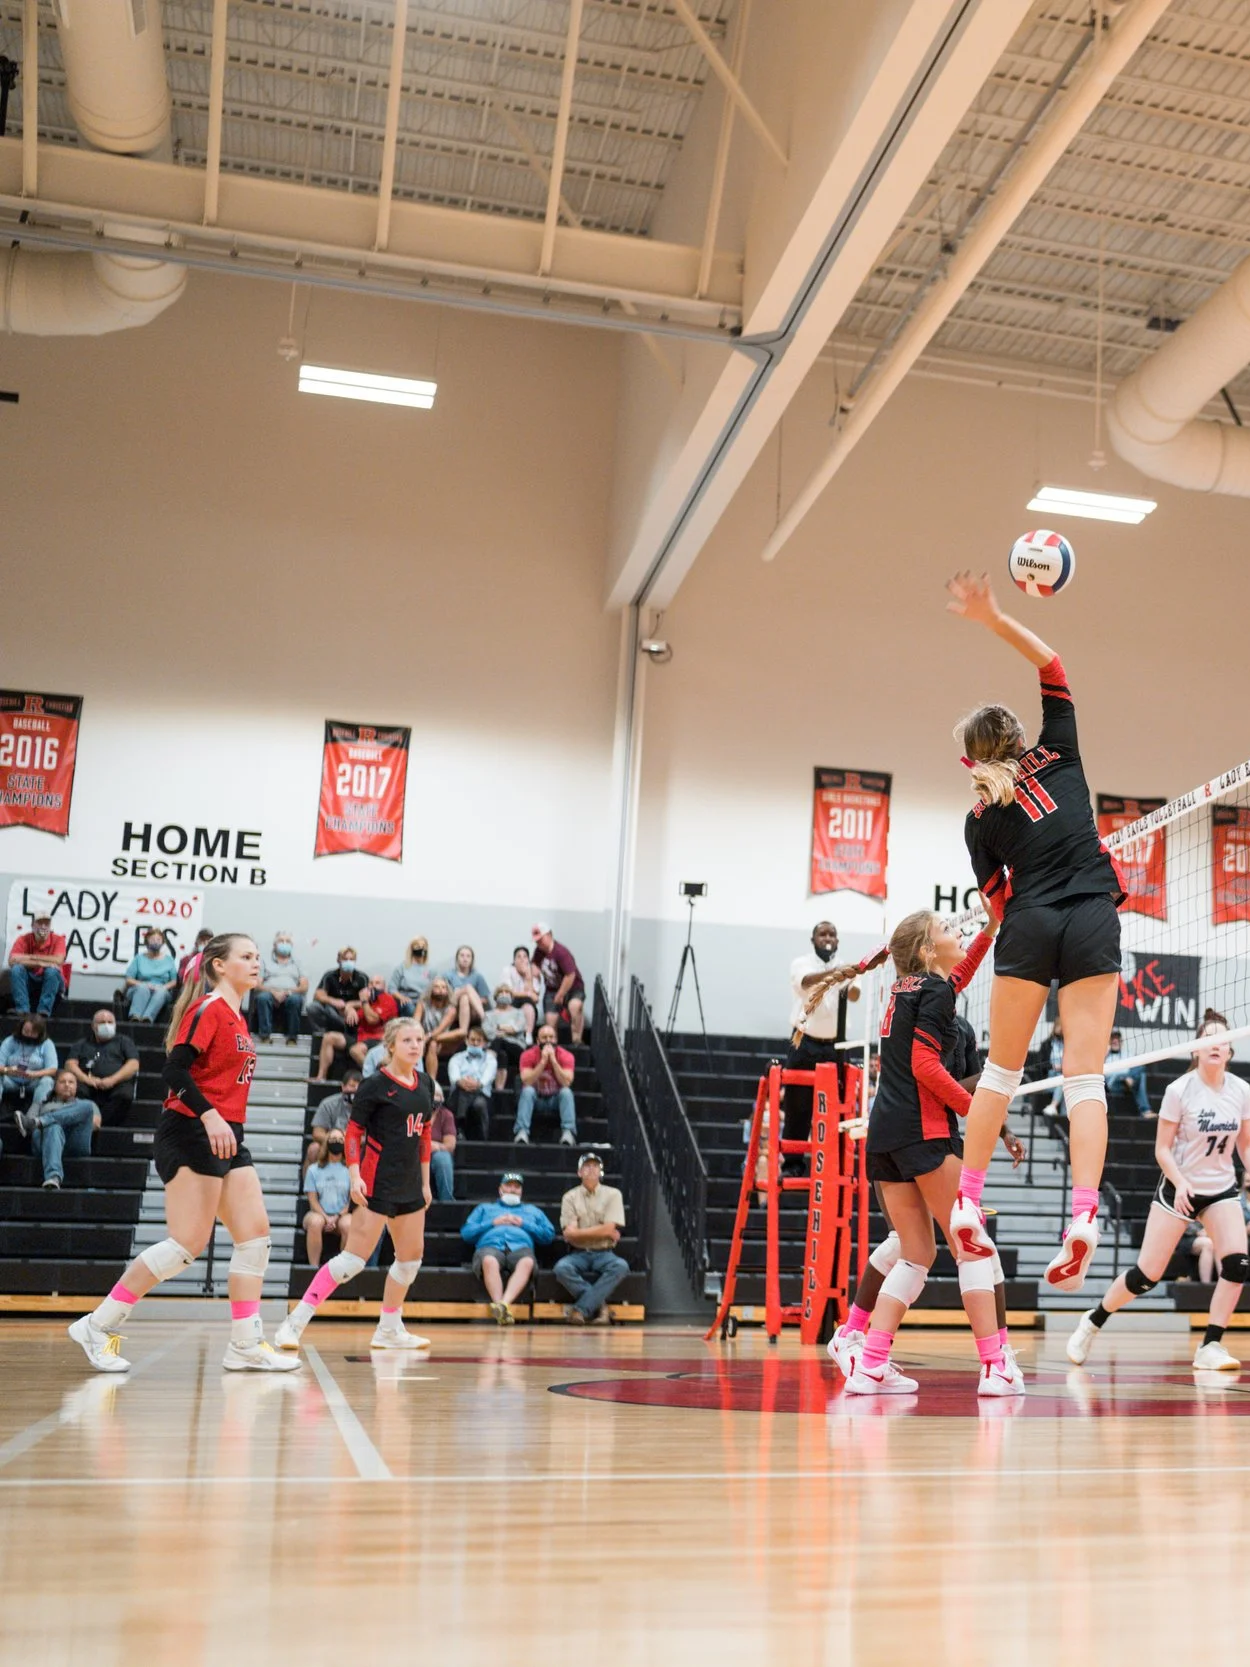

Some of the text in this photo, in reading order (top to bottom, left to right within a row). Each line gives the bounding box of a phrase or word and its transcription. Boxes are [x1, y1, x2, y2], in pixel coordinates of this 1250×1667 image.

[1017, 556, 1050, 571] Wilson
[13, 717, 51, 732] BASEBALL
[0, 733, 59, 770] 2016
[7, 773, 45, 791] STATE
[336, 763, 392, 799] 2017
[1150, 791, 1197, 827] VOLLEYBALL
[1204, 783, 1212, 797] R
[1219, 768, 1242, 789] LADY
[0, 789, 62, 810] AMPIONS
[1014, 776, 1059, 822] 11
[122, 821, 263, 861] HOME
[325, 815, 395, 835] CHAMPIONS
[828, 807, 873, 841] 2011
[111, 858, 267, 886] SECTION B
[22, 887, 119, 922] LADY
[136, 897, 193, 919] 2020
[32, 917, 178, 963] AGLES
[1135, 994, 1196, 1028] WIN
[407, 1112, 424, 1137] 14
[803, 1091, 827, 1320] ROSEHILL
